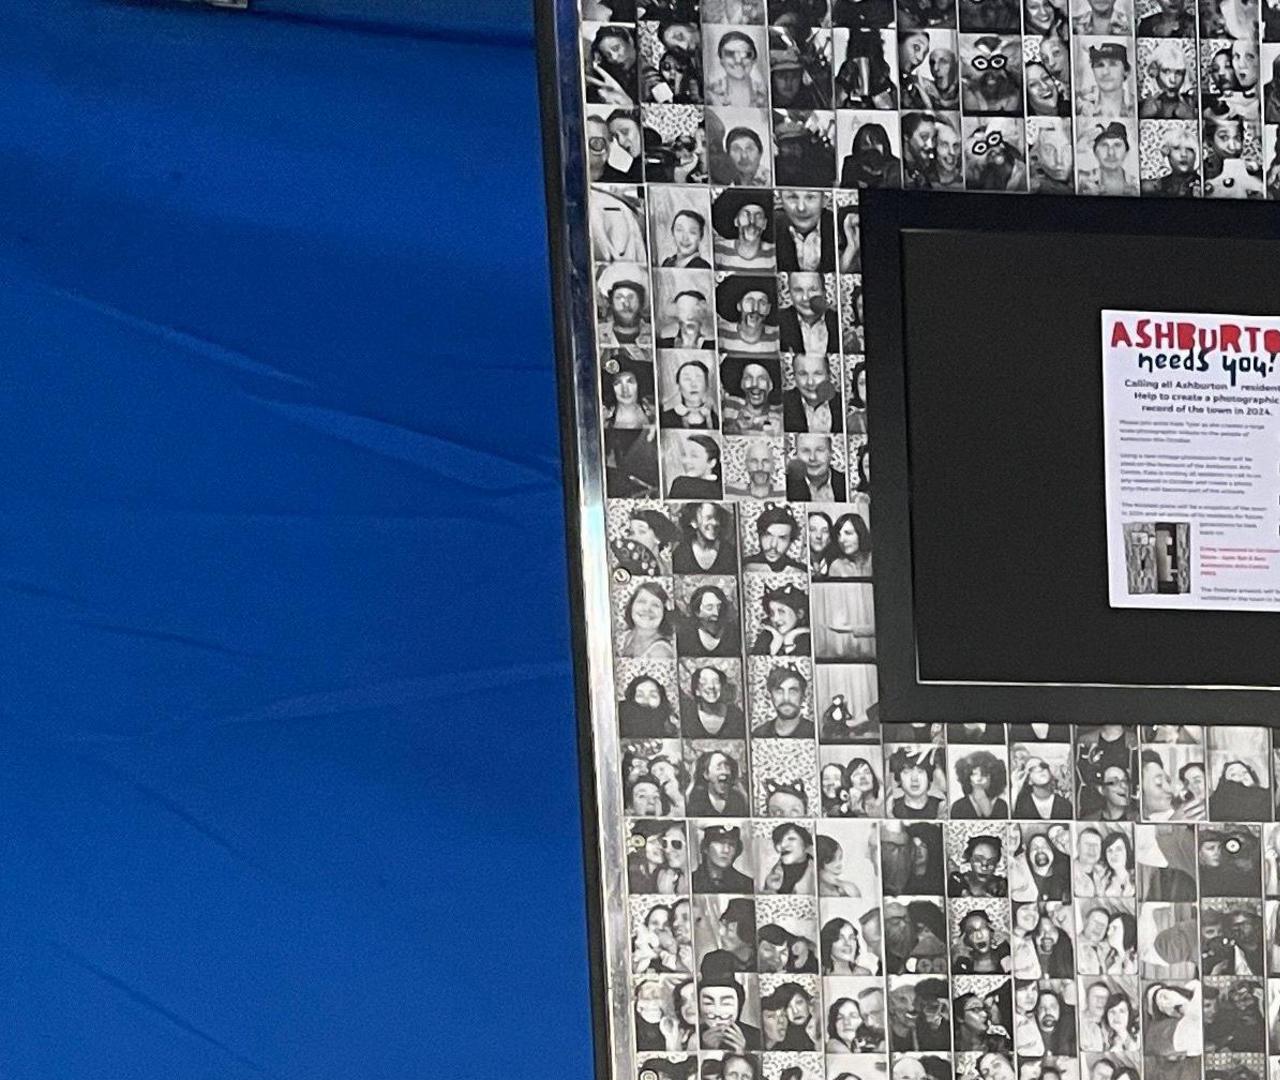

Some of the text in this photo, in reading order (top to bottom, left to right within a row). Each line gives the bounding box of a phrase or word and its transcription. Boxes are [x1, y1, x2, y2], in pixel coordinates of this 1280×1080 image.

[1222, 351, 1278, 387] you!
[1124, 379, 1158, 389] Calling
[1161, 381, 1173, 389] all
[1175, 381, 1228, 390] Ashburton
[1134, 391, 1157, 401] Help
[1159, 393, 1170, 401] to
[1171, 394, 1203, 402] create
[1213, 394, 1280, 405] photographic
[1141, 404, 1174, 412] record
[1175, 404, 1187, 413] of
[1187, 405, 1204, 413] the
[1234, 407, 1244, 415] in
